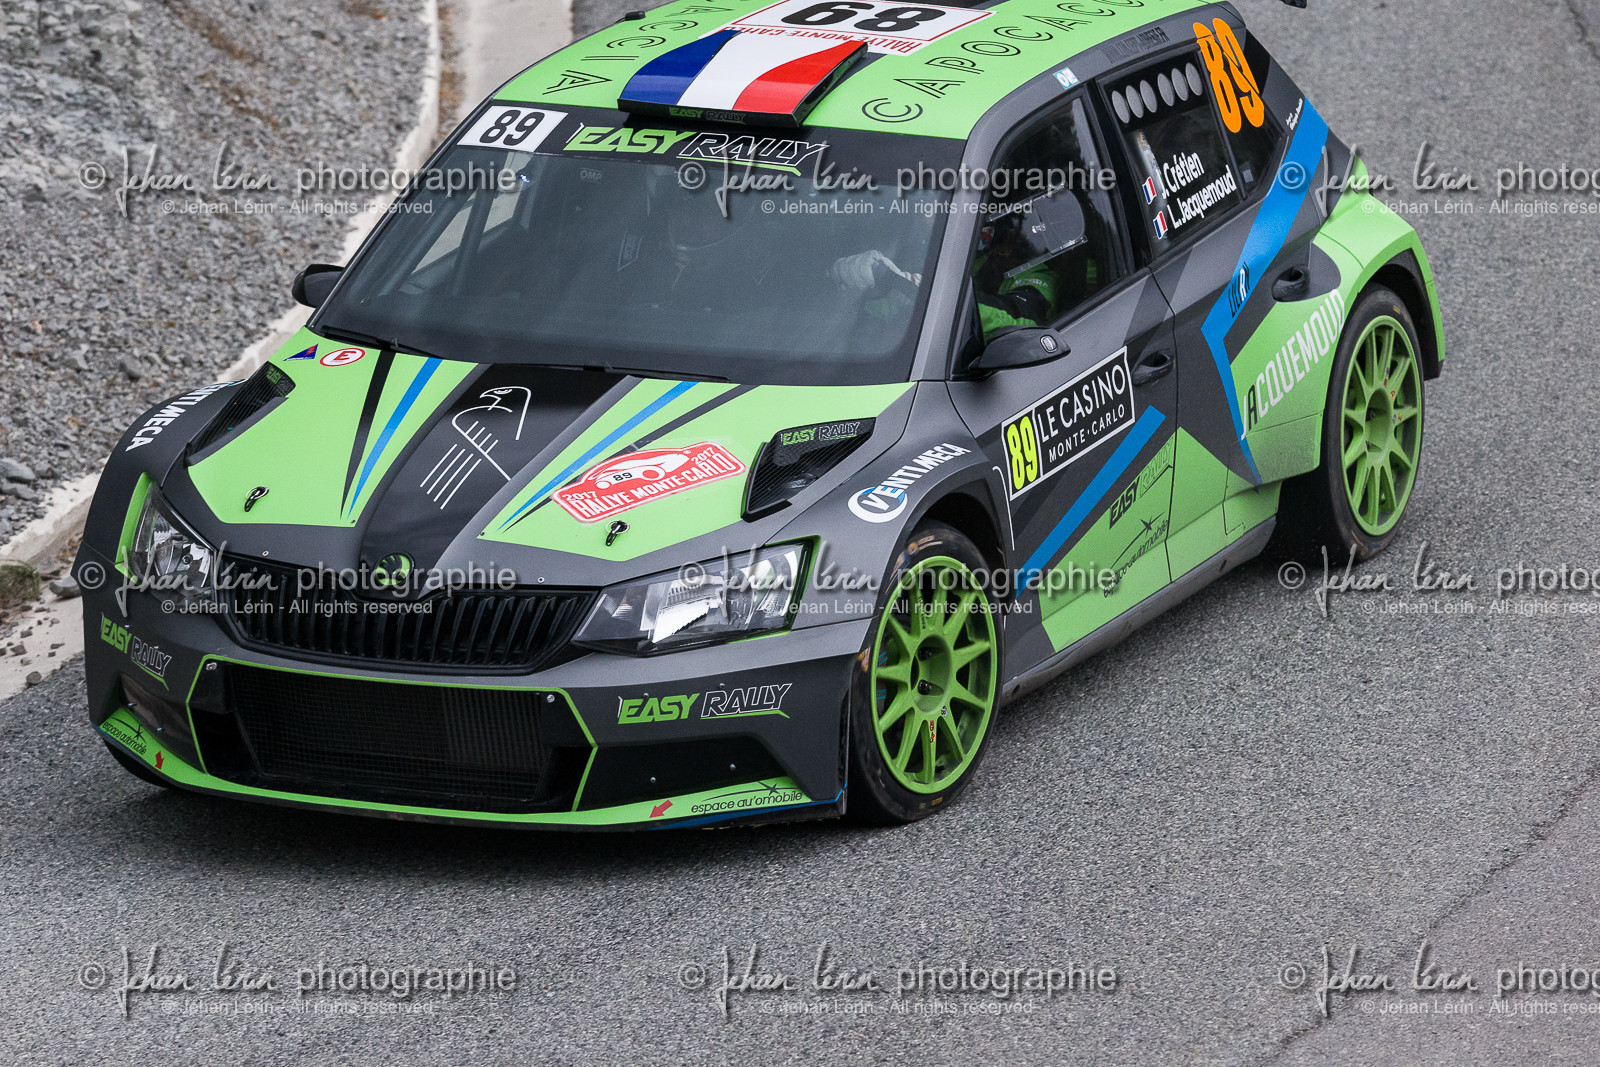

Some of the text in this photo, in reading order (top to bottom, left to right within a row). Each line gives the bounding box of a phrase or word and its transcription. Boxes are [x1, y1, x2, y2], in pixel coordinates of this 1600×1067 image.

[780, 1, 947, 32] 89
[542, 0, 735, 95] ACCIA
[1192, 17, 1265, 134] 89
[479, 109, 546, 146] 89
[669, 106, 748, 122] EASY RALLY
[563, 125, 831, 167] EASY RALLY
[1240, 288, 1345, 441] JACQUEMOUD
[1037, 364, 1126, 443] LE CASINO
[780, 421, 861, 446] EASY RALLY
[1006, 415, 1039, 491] 89
[612, 471, 633, 482] 89
[690, 446, 716, 465] 2017
[562, 490, 599, 502] 2017
[568, 452, 737, 518] RALLYE MONTE-CARLO
[1108, 475, 1141, 530] EASY
[101, 616, 173, 678] EASY RALLY
[617, 683, 793, 725] EASY RALLY
[102, 721, 122, 739] espace
[690, 800, 735, 815] espace
